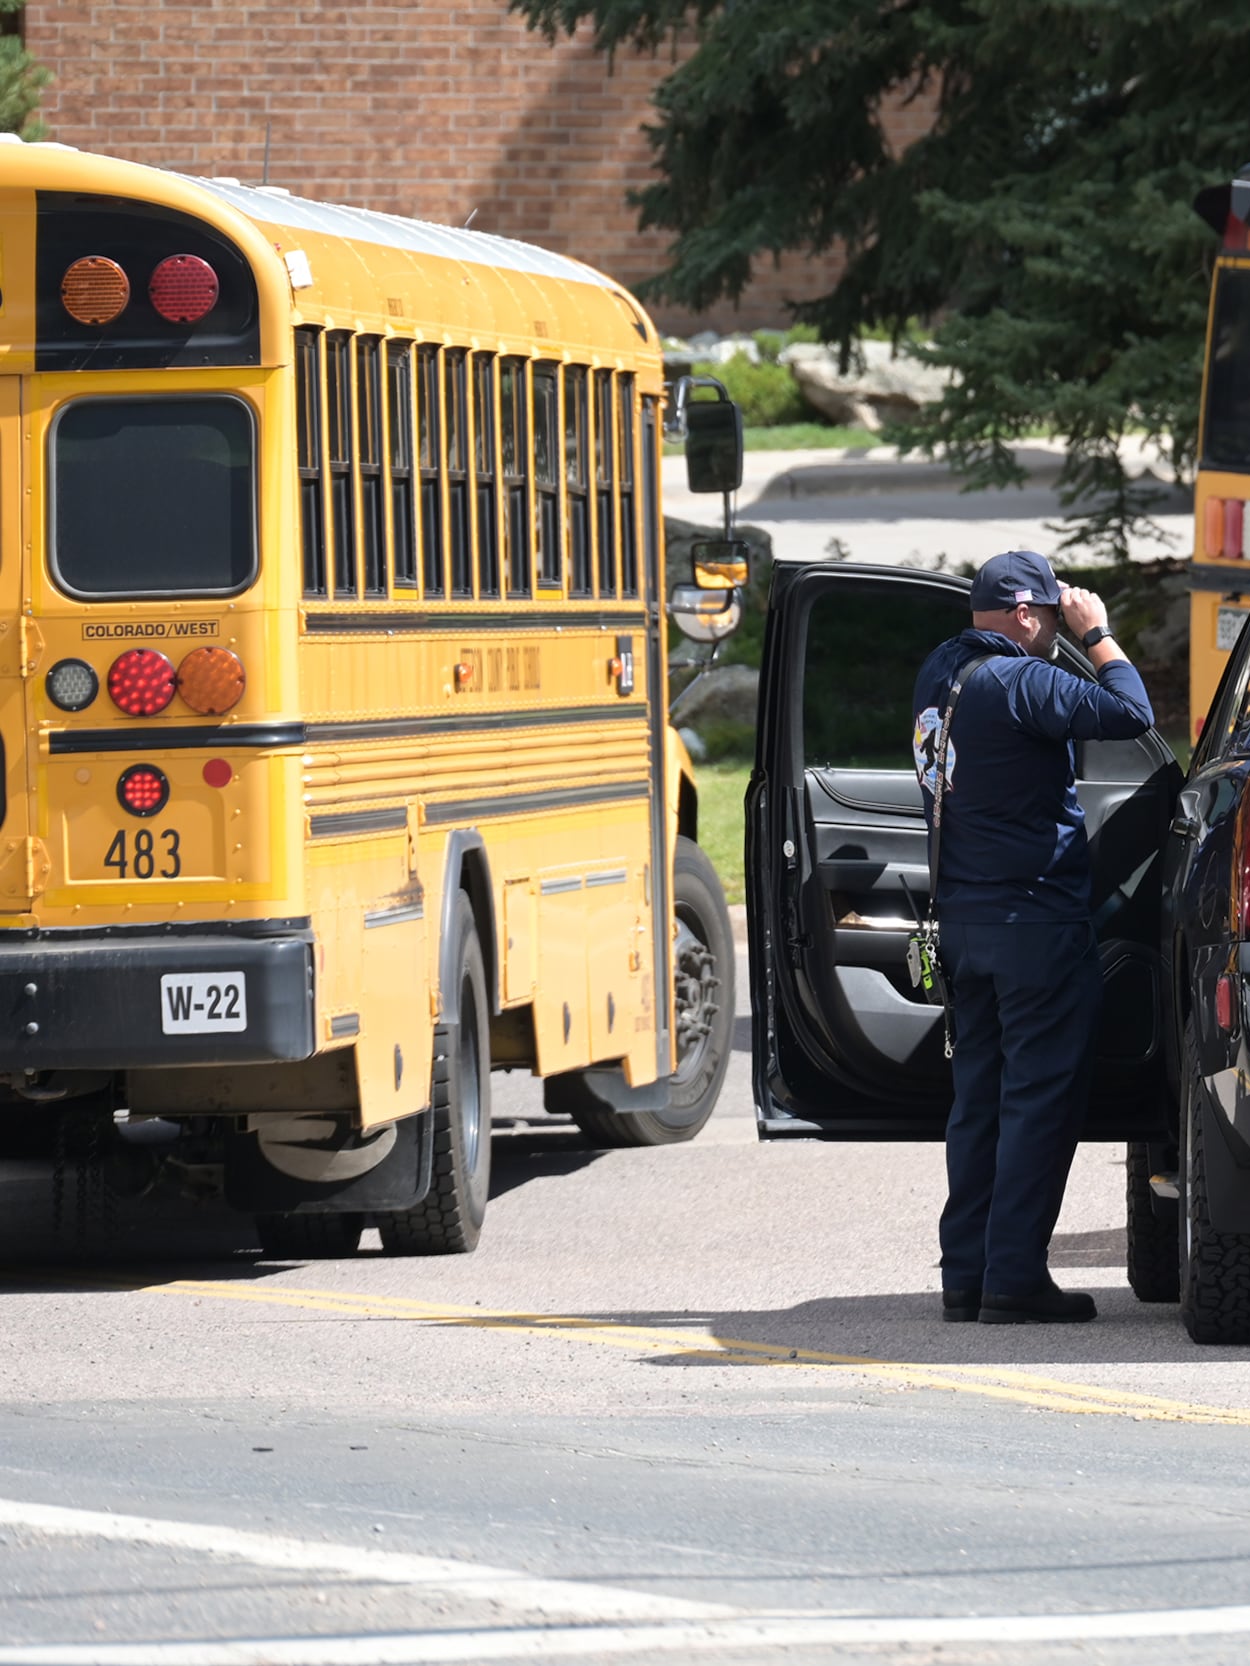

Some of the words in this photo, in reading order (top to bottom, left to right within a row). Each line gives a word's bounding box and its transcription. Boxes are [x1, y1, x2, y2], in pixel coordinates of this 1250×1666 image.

[85, 622, 217, 638] COLORADO/WEST
[103, 828, 182, 879] 483
[167, 983, 241, 1022] W-22
